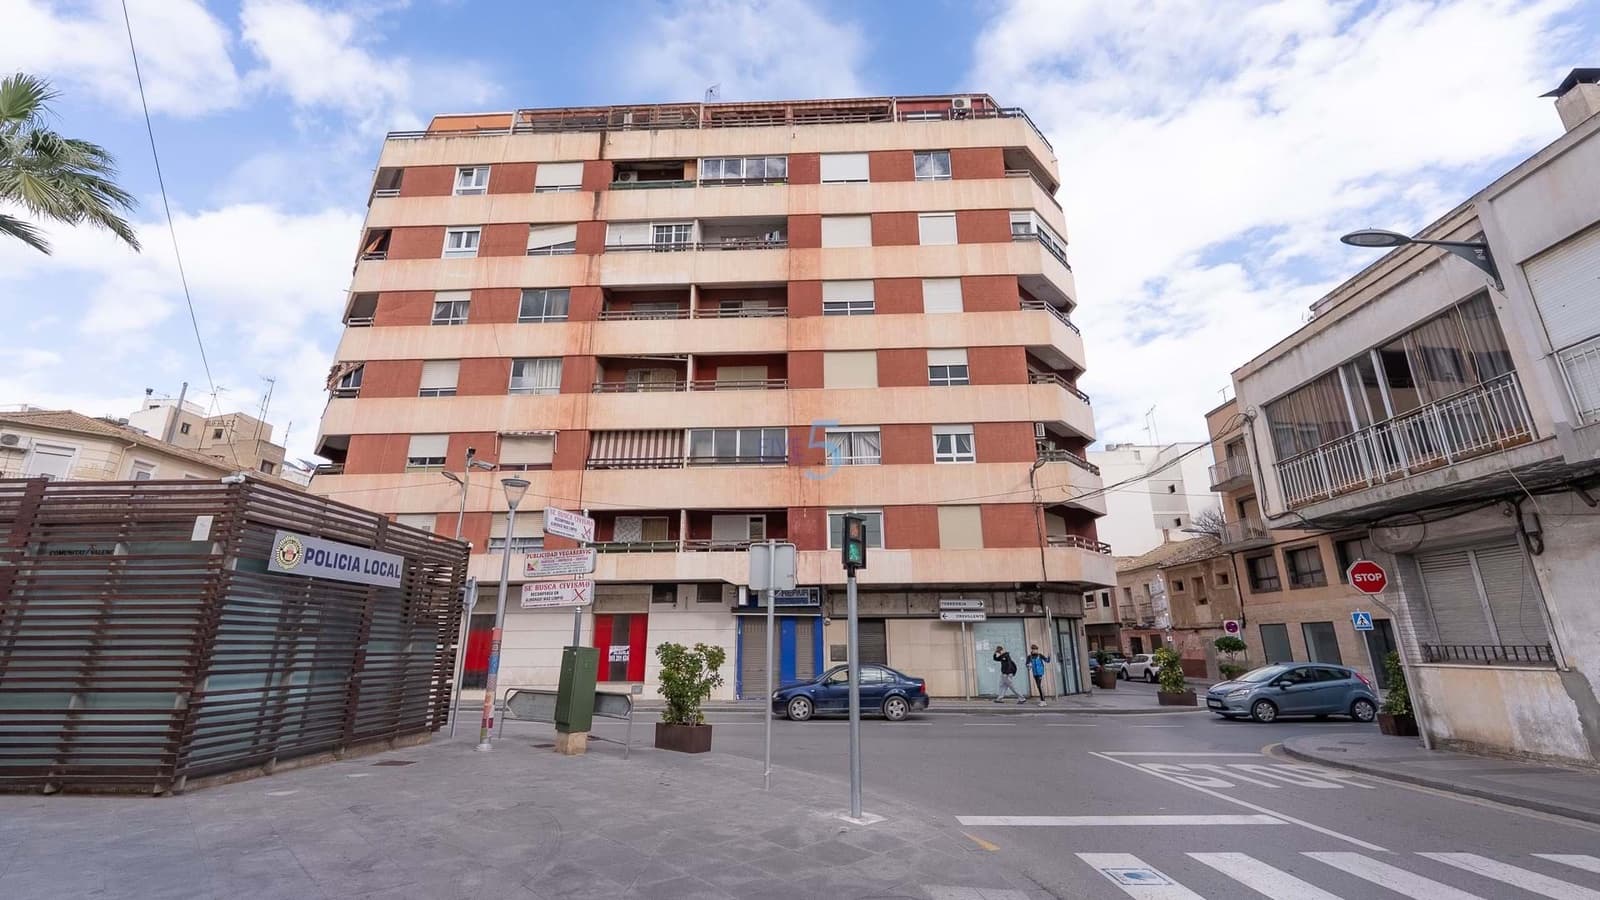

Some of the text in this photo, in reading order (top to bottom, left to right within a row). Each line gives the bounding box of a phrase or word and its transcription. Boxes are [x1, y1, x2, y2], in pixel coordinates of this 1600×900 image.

[526, 551, 558, 559] PUBLICIDAD
[304, 547, 400, 578] POLICIA LOCAL
[1354, 573, 1382, 582] STOP
[534, 583, 557, 591] BUSCA
[559, 581, 590, 589] CIVISMO
